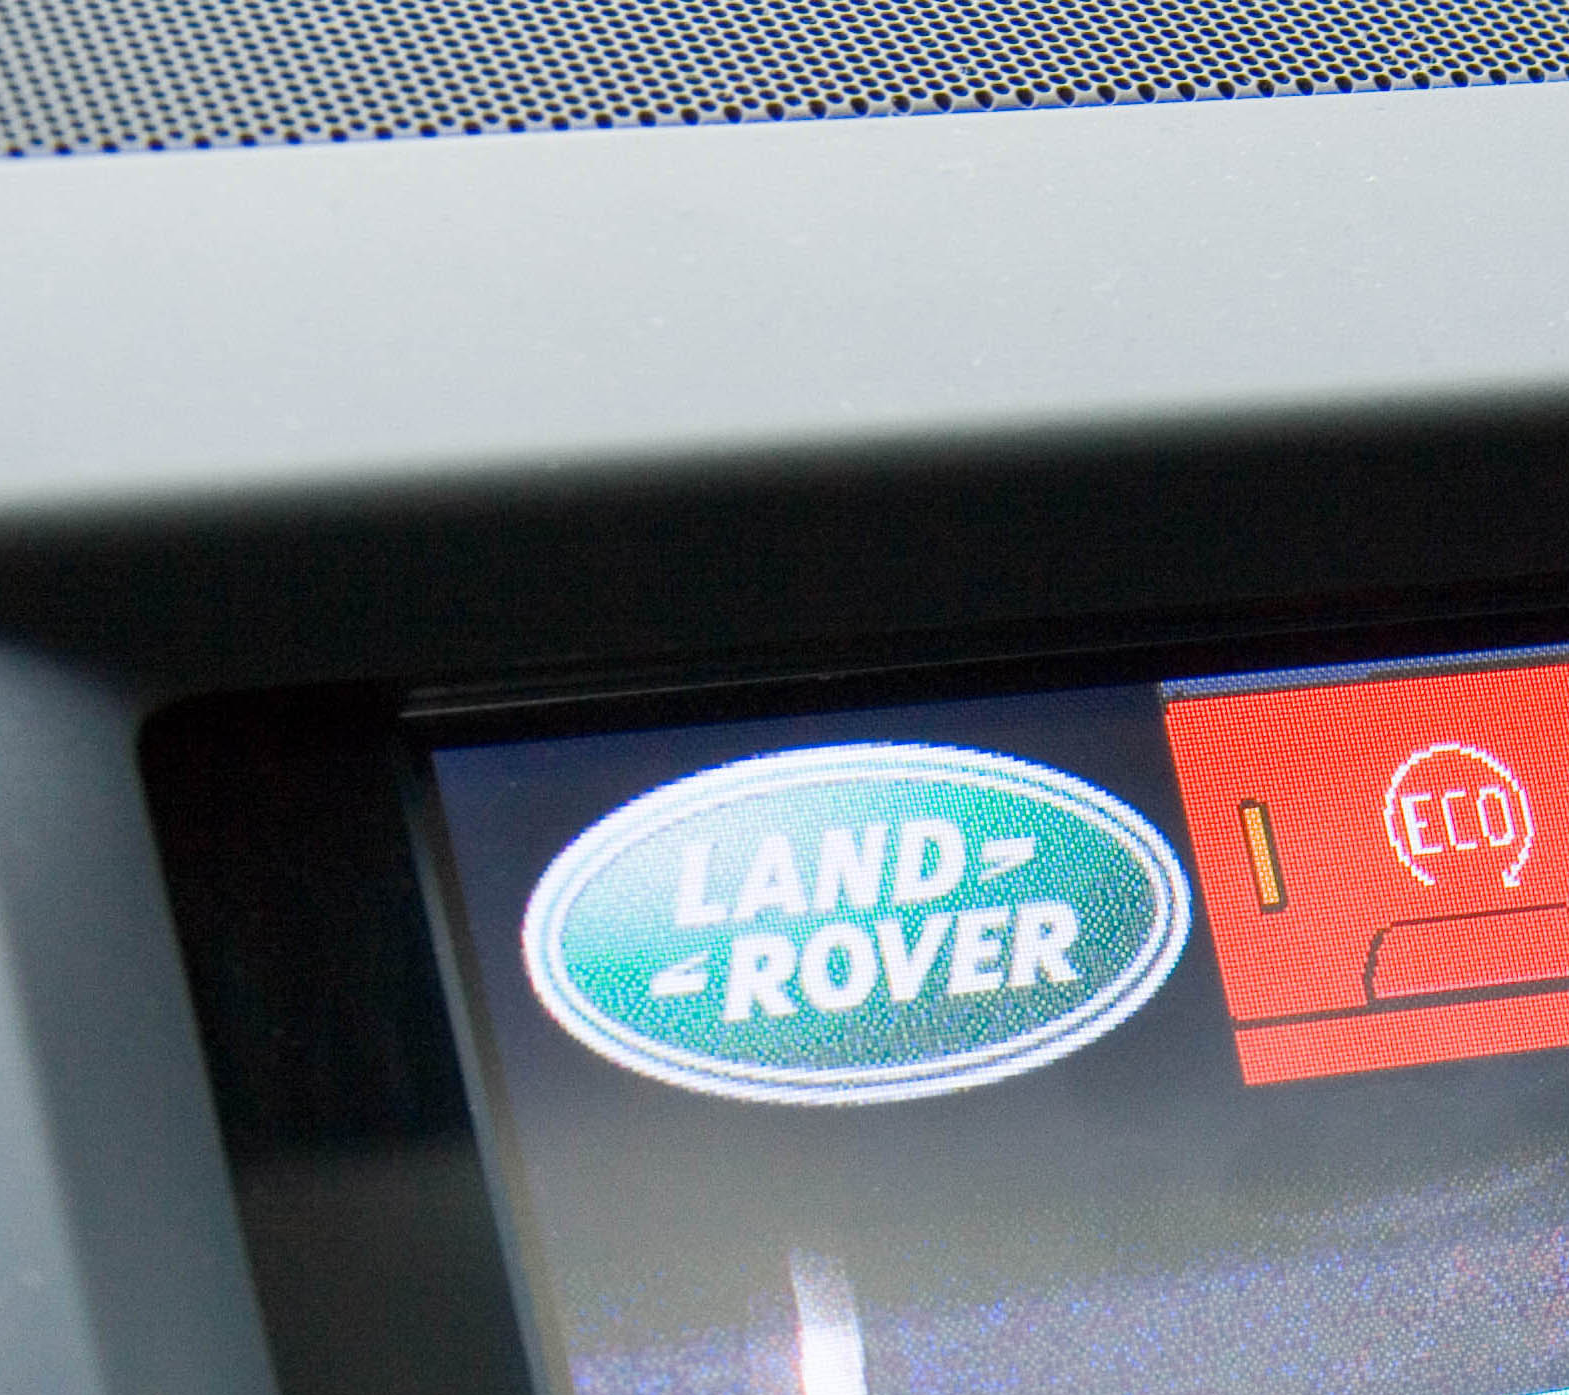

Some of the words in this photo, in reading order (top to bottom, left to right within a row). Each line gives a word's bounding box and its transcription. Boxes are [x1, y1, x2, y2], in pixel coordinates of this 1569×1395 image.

[672, 816, 967, 929] LAND
[1400, 783, 1516, 857] ECO
[723, 900, 1082, 1024] ROVER
